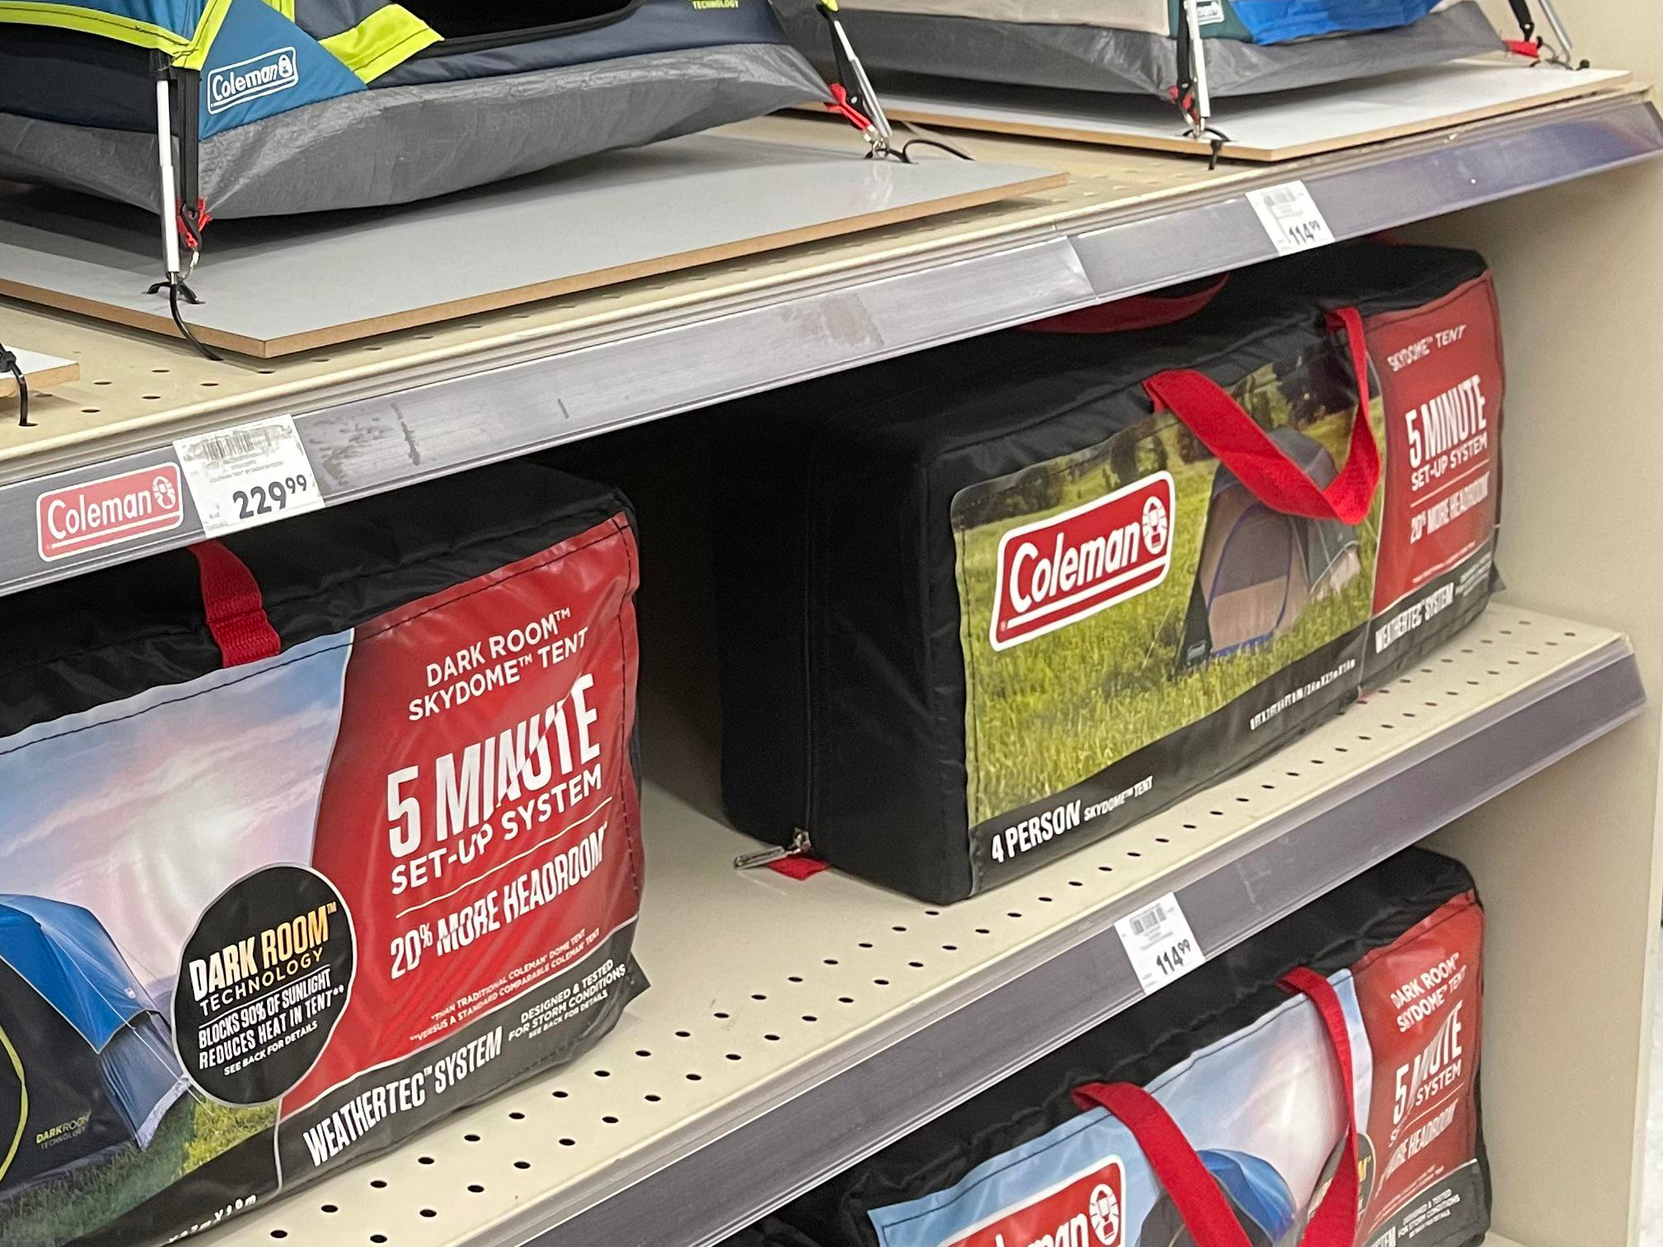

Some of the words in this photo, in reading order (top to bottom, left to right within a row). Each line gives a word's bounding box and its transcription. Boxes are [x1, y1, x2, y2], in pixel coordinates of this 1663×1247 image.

[212, 64, 279, 101] Coleman
[1435, 324, 1466, 348] TENT
[1405, 409, 1422, 468] 5
[1421, 374, 1487, 461] MINUTE
[1411, 455, 1448, 491] SET-UP
[1450, 432, 1488, 469] SYSTEM
[46, 487, 152, 540] Coleman
[1009, 522, 1140, 613] Coleman
[426, 641, 486, 687] DARK
[537, 626, 588, 668] TENT
[387, 765, 422, 858] 5
[435, 673, 601, 842] MINUTE
[391, 823, 493, 896] SET-UP
[501, 763, 602, 841] SYSTEM
[991, 834, 1005, 863] 4
[1005, 799, 1081, 858] PERSON
[1134, 775, 1153, 798] TENT
[390, 922, 434, 980] 20%
[436, 890, 501, 957] MORE
[456, 977, 507, 1006] TRADITIONAL
[549, 943, 570, 959] DOME
[570, 928, 586, 947] TENT
[188, 936, 258, 1002] DARK
[199, 947, 323, 1016] TECHNOLOGY
[449, 1015, 457, 1025] A
[458, 990, 499, 1022] STANDARD
[499, 962, 550, 997] COMPARABLE
[508, 1023, 530, 1041] FOR
[532, 1002, 567, 1029] STORM
[568, 963, 626, 1007] CONDITIONS
[520, 991, 571, 1024] DESIGNED
[572, 984, 580, 994] &
[581, 958, 614, 988] TESTED
[198, 1010, 241, 1049] BLOCKS
[240, 1002, 267, 1028] 90%
[267, 996, 280, 1017] OF
[281, 968, 331, 1009] SUNLIGHT
[199, 1028, 256, 1070] REDUCES
[258, 1013, 287, 1045] HEAT
[290, 1004, 303, 1028] IN
[543, 1016, 563, 1032] BACK
[564, 1008, 579, 1021] FOR
[579, 991, 608, 1012] DETAILS
[224, 1062, 241, 1076] SEE
[243, 1050, 267, 1068] BACK
[267, 1039, 284, 1056] FOR
[285, 1020, 318, 1045] DETAILS
[434, 1025, 503, 1095] SYSTEM
[1393, 1063, 1409, 1125] 5
[1416, 1059, 1462, 1106] SYSTEM
